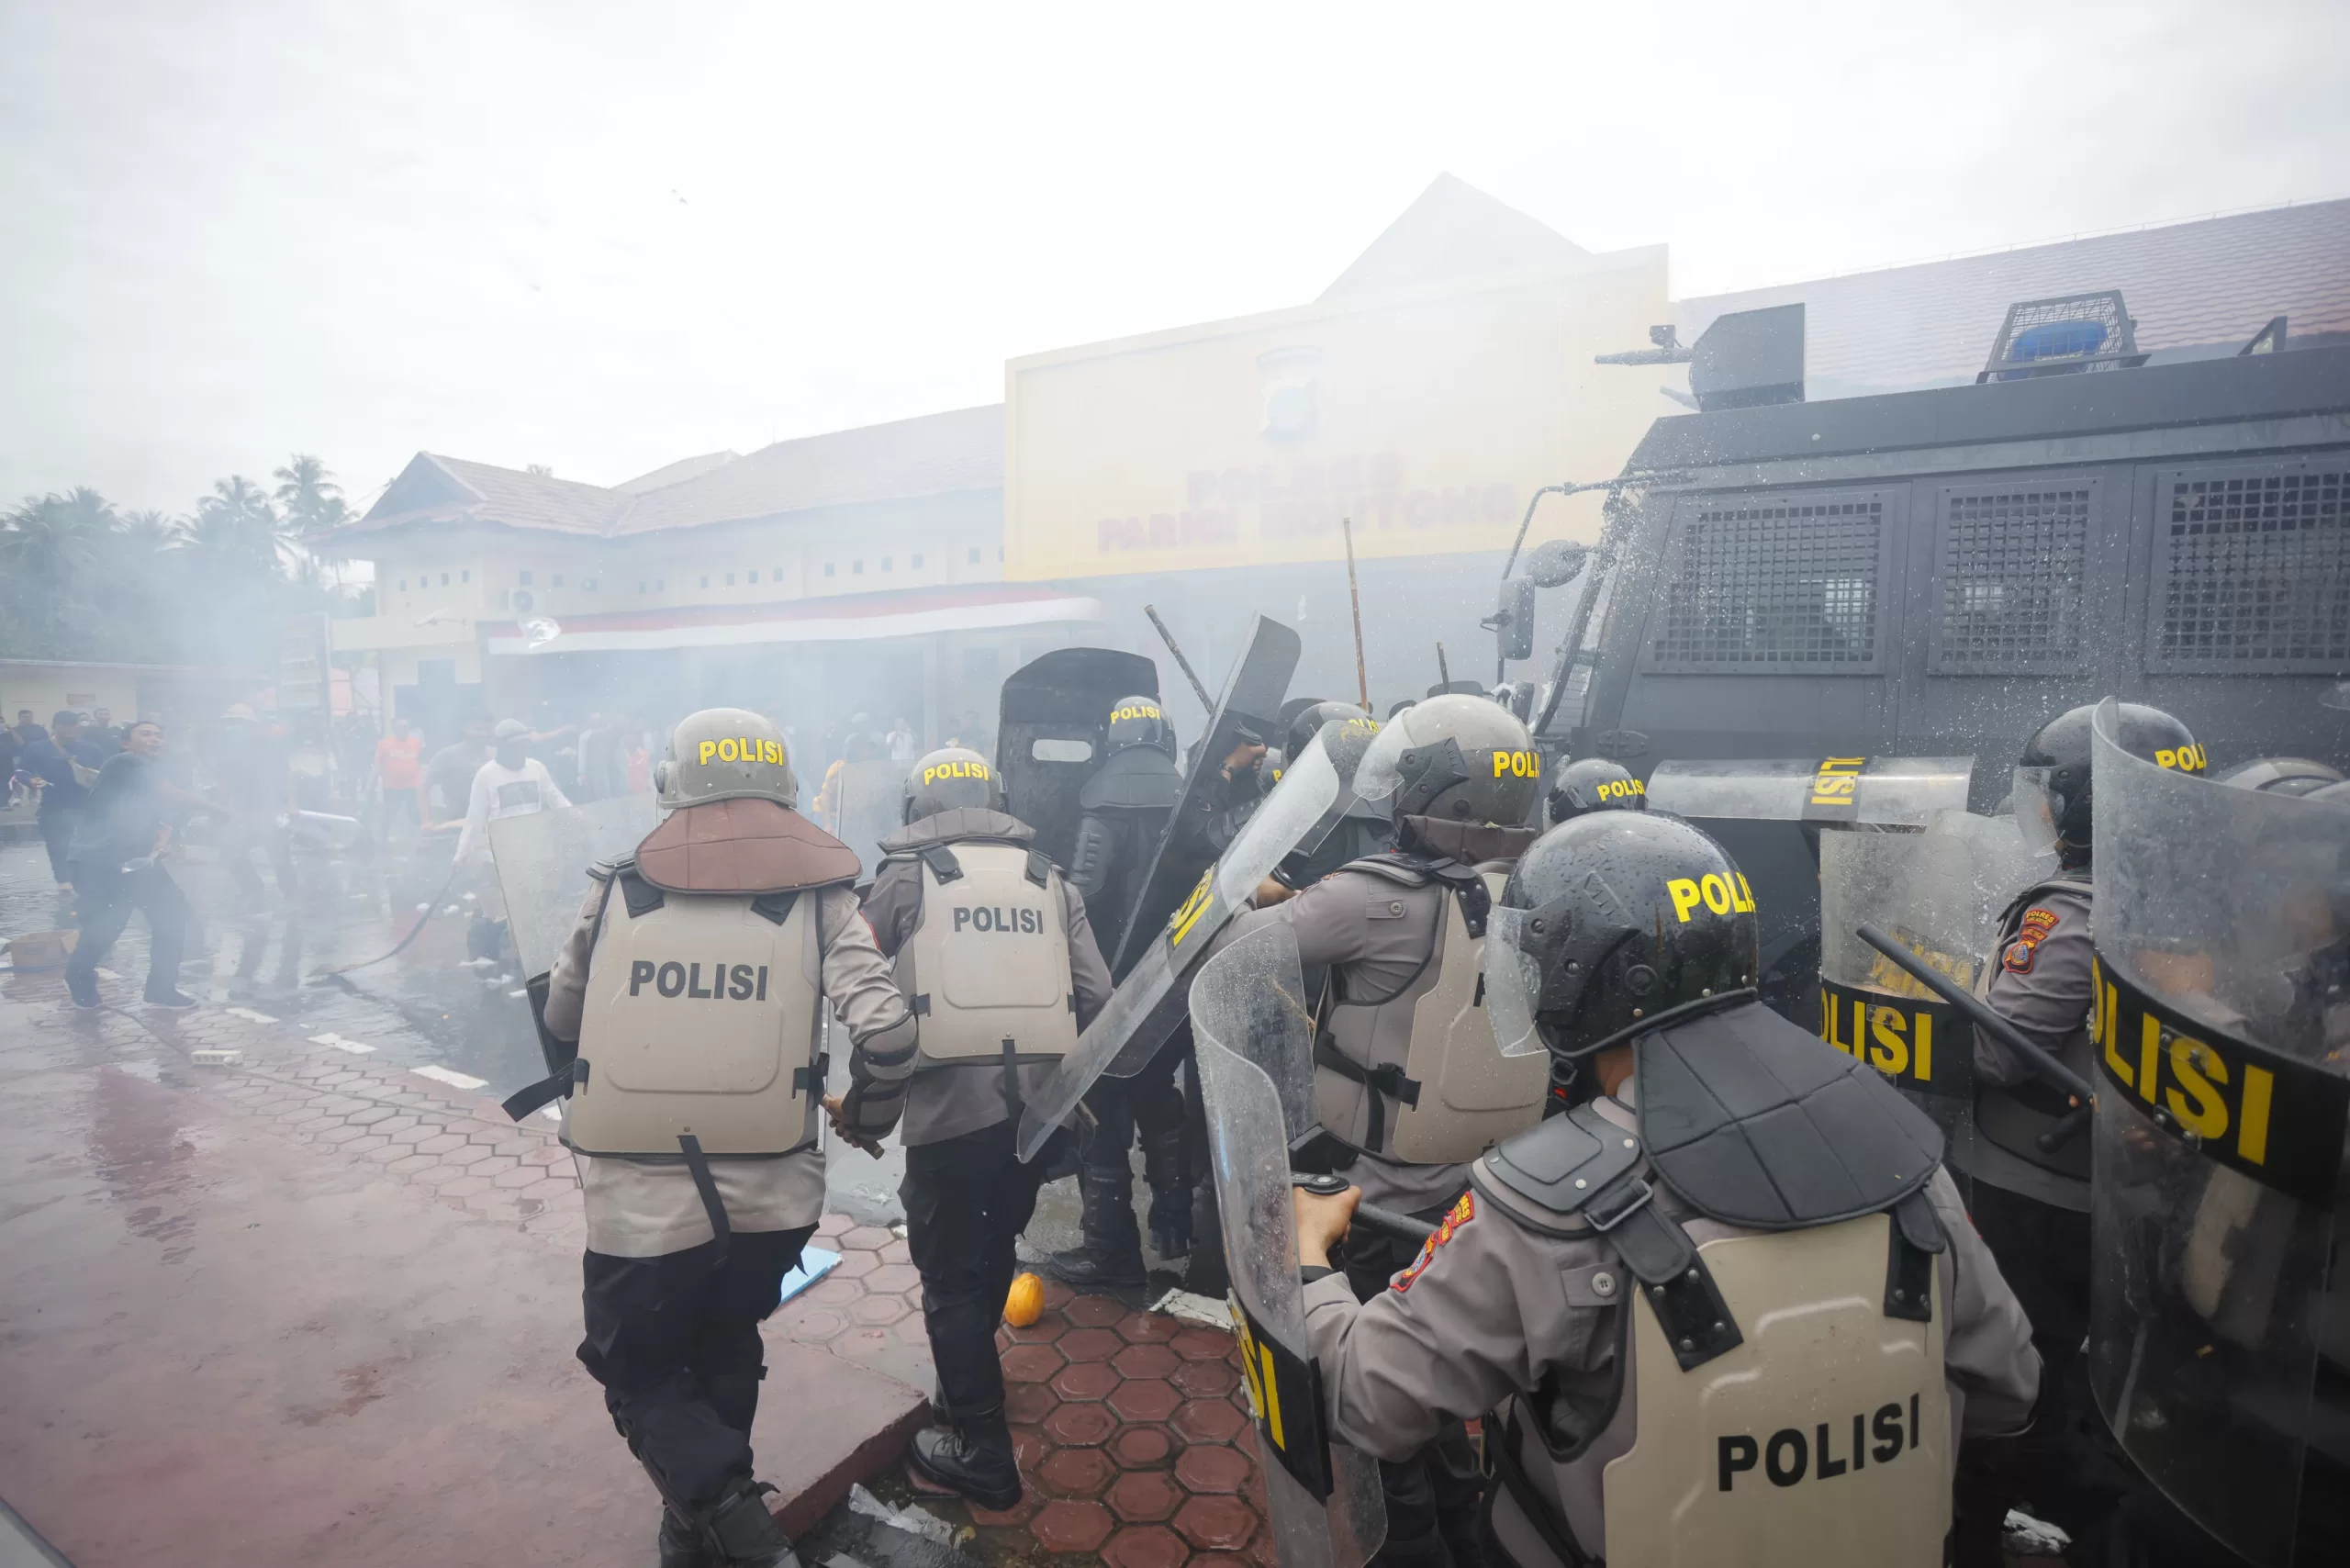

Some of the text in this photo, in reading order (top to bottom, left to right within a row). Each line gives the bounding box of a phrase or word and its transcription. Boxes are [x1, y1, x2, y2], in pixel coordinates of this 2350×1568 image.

[1110, 704, 1160, 724] POLISI
[698, 737, 784, 766] POLISI
[923, 760, 990, 786] POLISI
[1666, 871, 1757, 924] POLI
[954, 906, 1044, 935] POLISI
[2026, 911, 2055, 924] POLRES
[630, 959, 768, 1002] POLISI
[1718, 1393, 1921, 1493] POLISI
